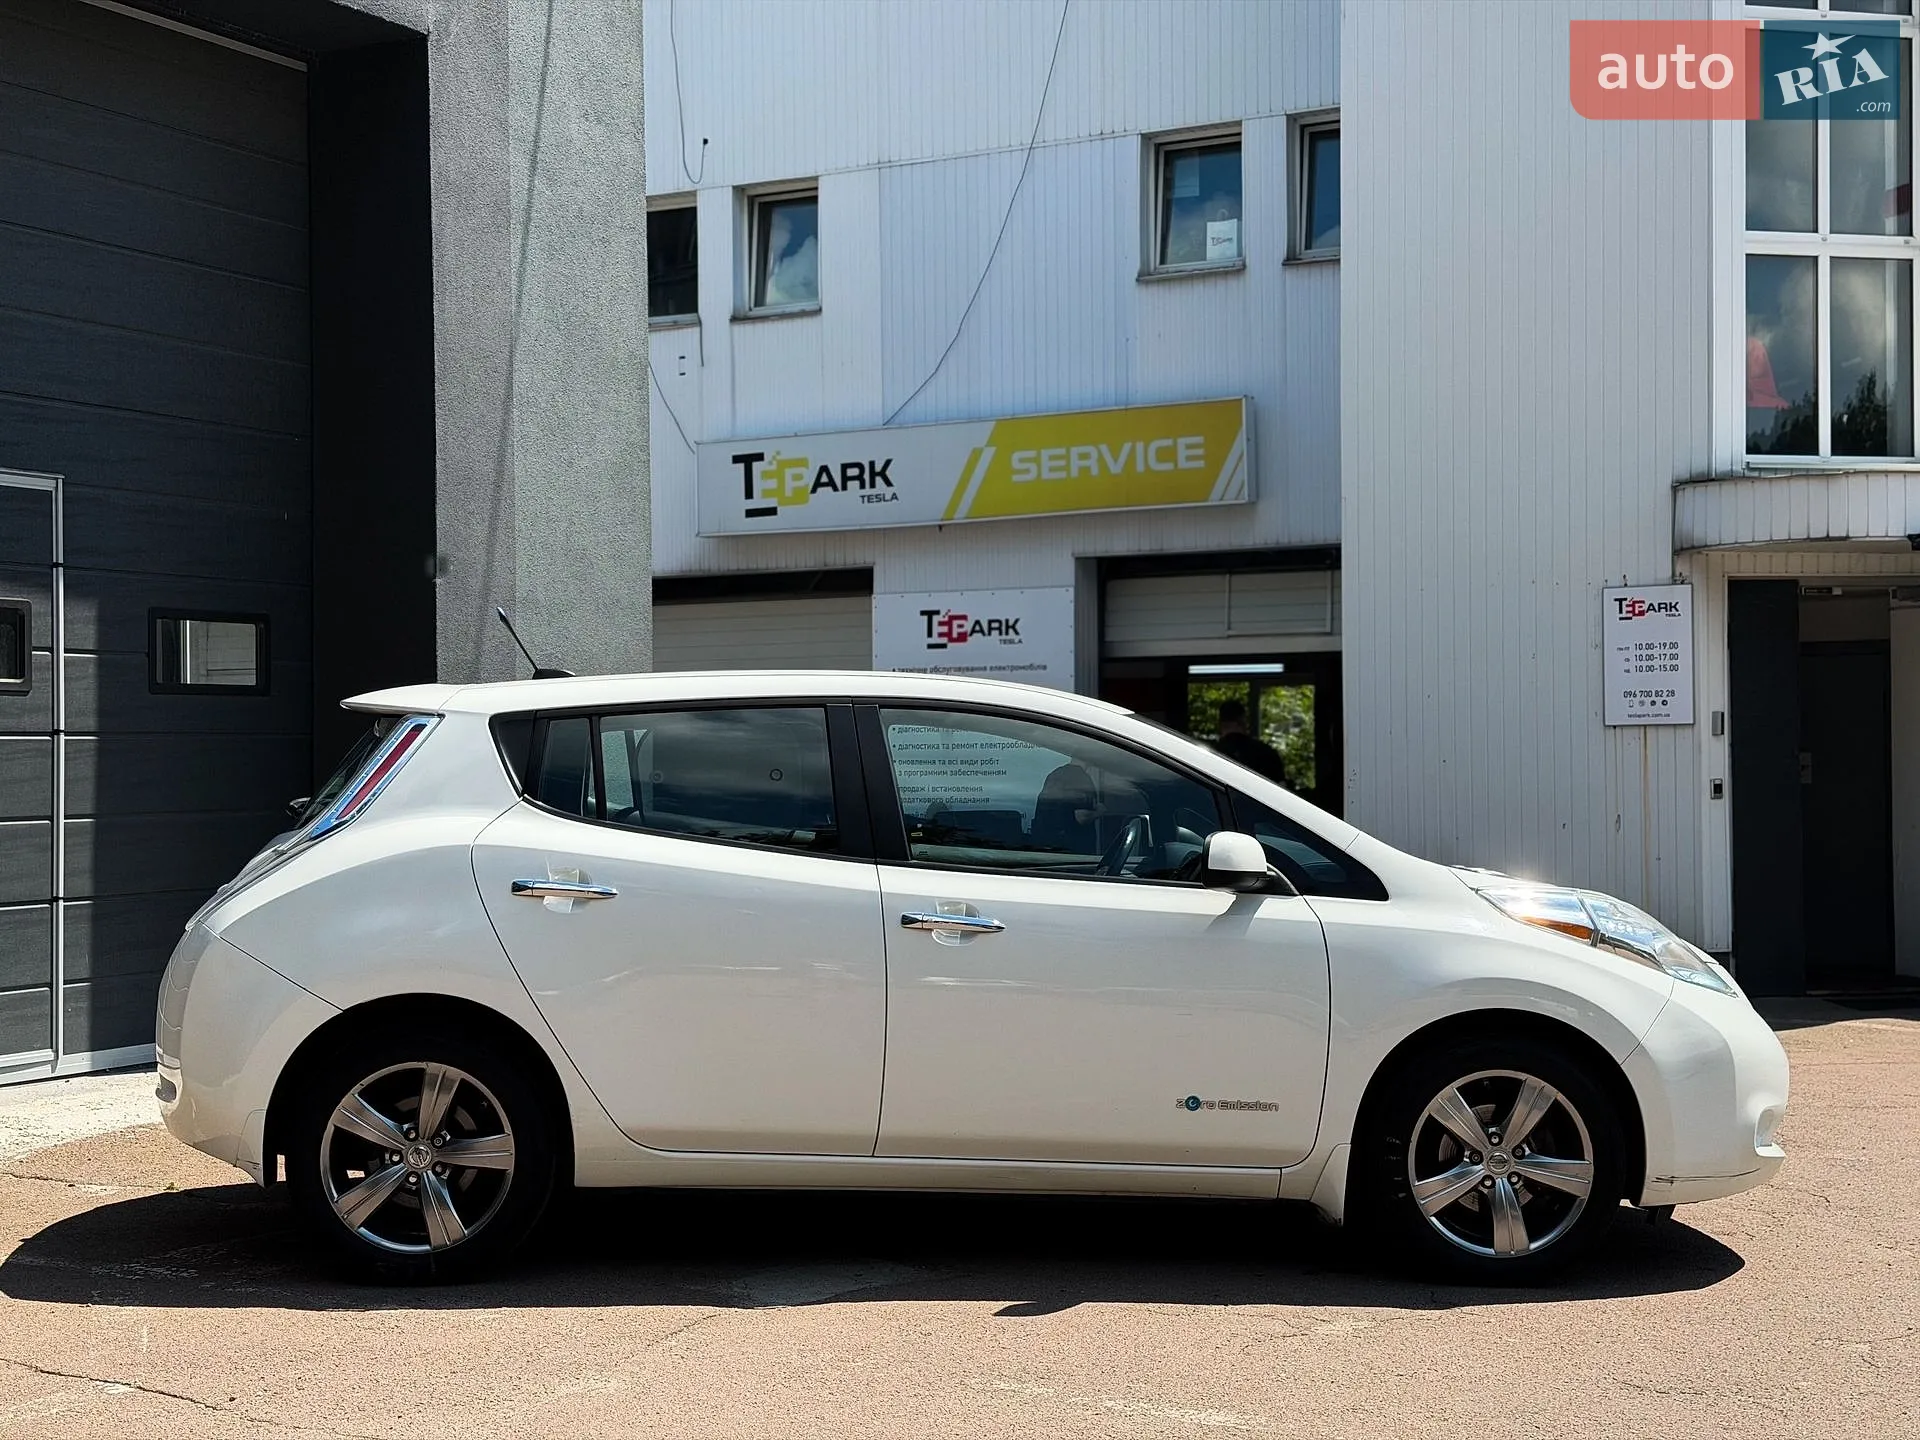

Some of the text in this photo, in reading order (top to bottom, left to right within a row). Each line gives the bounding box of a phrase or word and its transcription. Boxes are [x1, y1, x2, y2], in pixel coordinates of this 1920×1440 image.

[1011, 436, 1205, 482] SERVICE
[859, 491, 900, 505] TESLA
[1634, 641, 1679, 651] 10.00-19.00
[1634, 653, 1679, 662] 10.00-17.00
[1634, 664, 1679, 673] 10.00-15.00
[1623, 689, 1676, 698] 096 700 82 28
[897, 743, 941, 751] діагностика
[952, 743, 979, 751] ремонт
[898, 757, 999, 767] оновлення та всі види робіт
[931, 785, 984, 793] встановлення
[945, 796, 990, 804] обладнання
